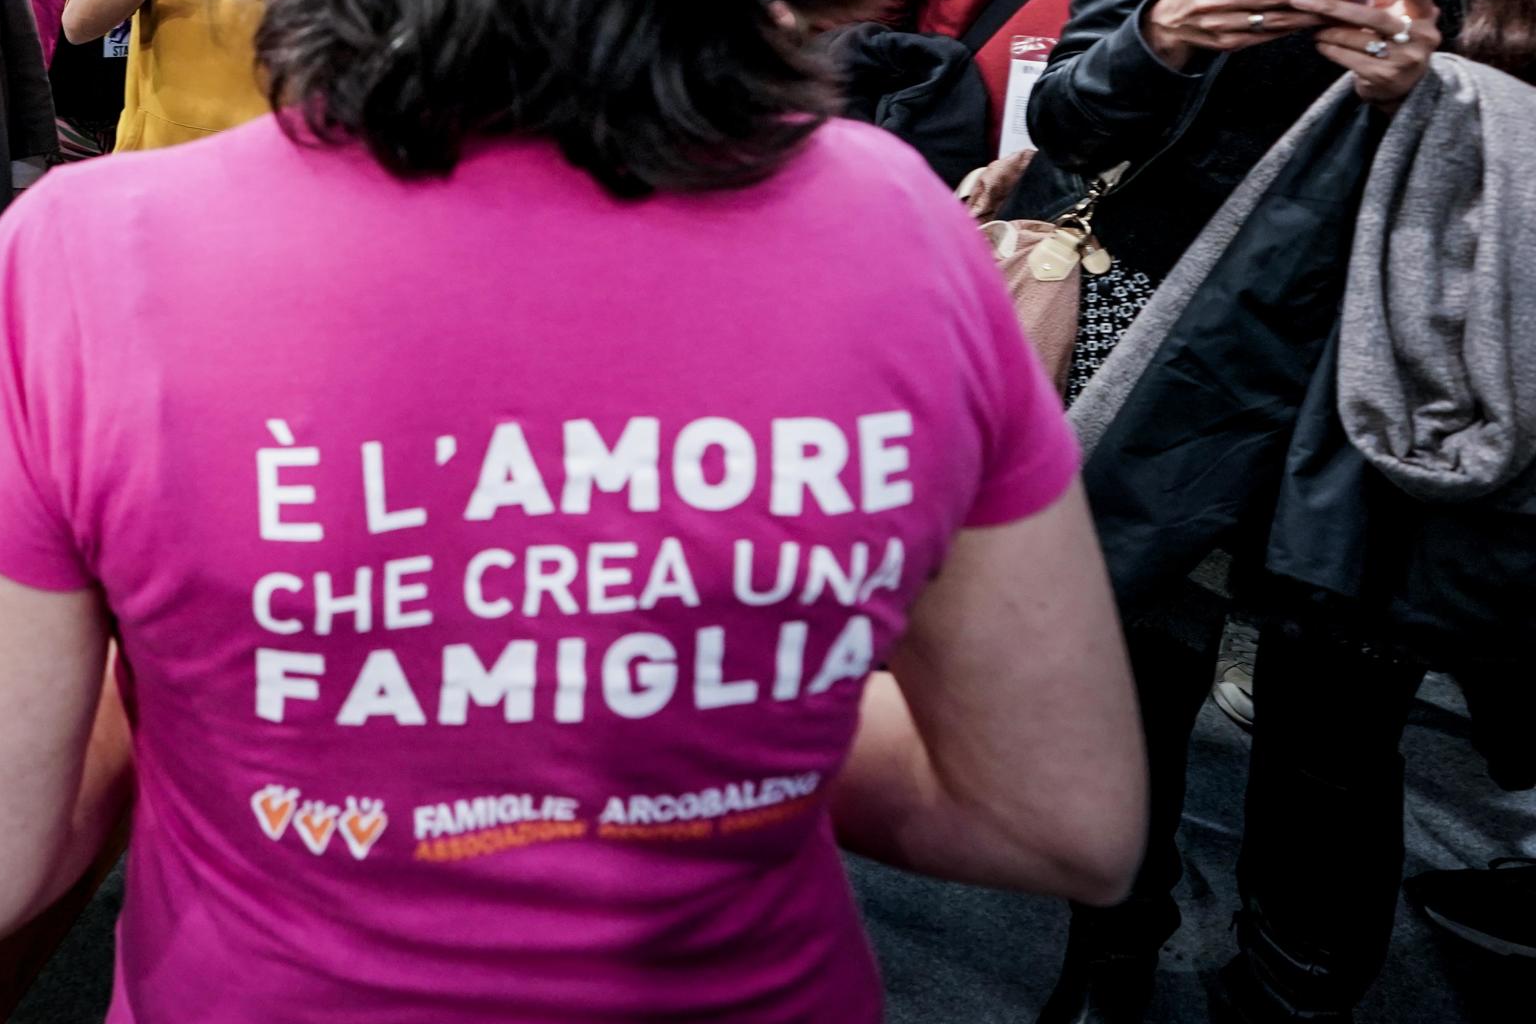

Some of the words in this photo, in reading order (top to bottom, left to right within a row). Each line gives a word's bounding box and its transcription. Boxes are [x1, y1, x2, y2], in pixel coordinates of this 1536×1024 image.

[255, 419, 325, 542] È
[362, 410, 915, 534] L'AMORE
[252, 555, 434, 635] CHE
[464, 536, 699, 619] CREA
[733, 536, 904, 608] UNA
[254, 615, 876, 726] FAMIGLIA
[414, 794, 580, 840] FAMIGLIE
[600, 773, 822, 825] ARCOBALENO
